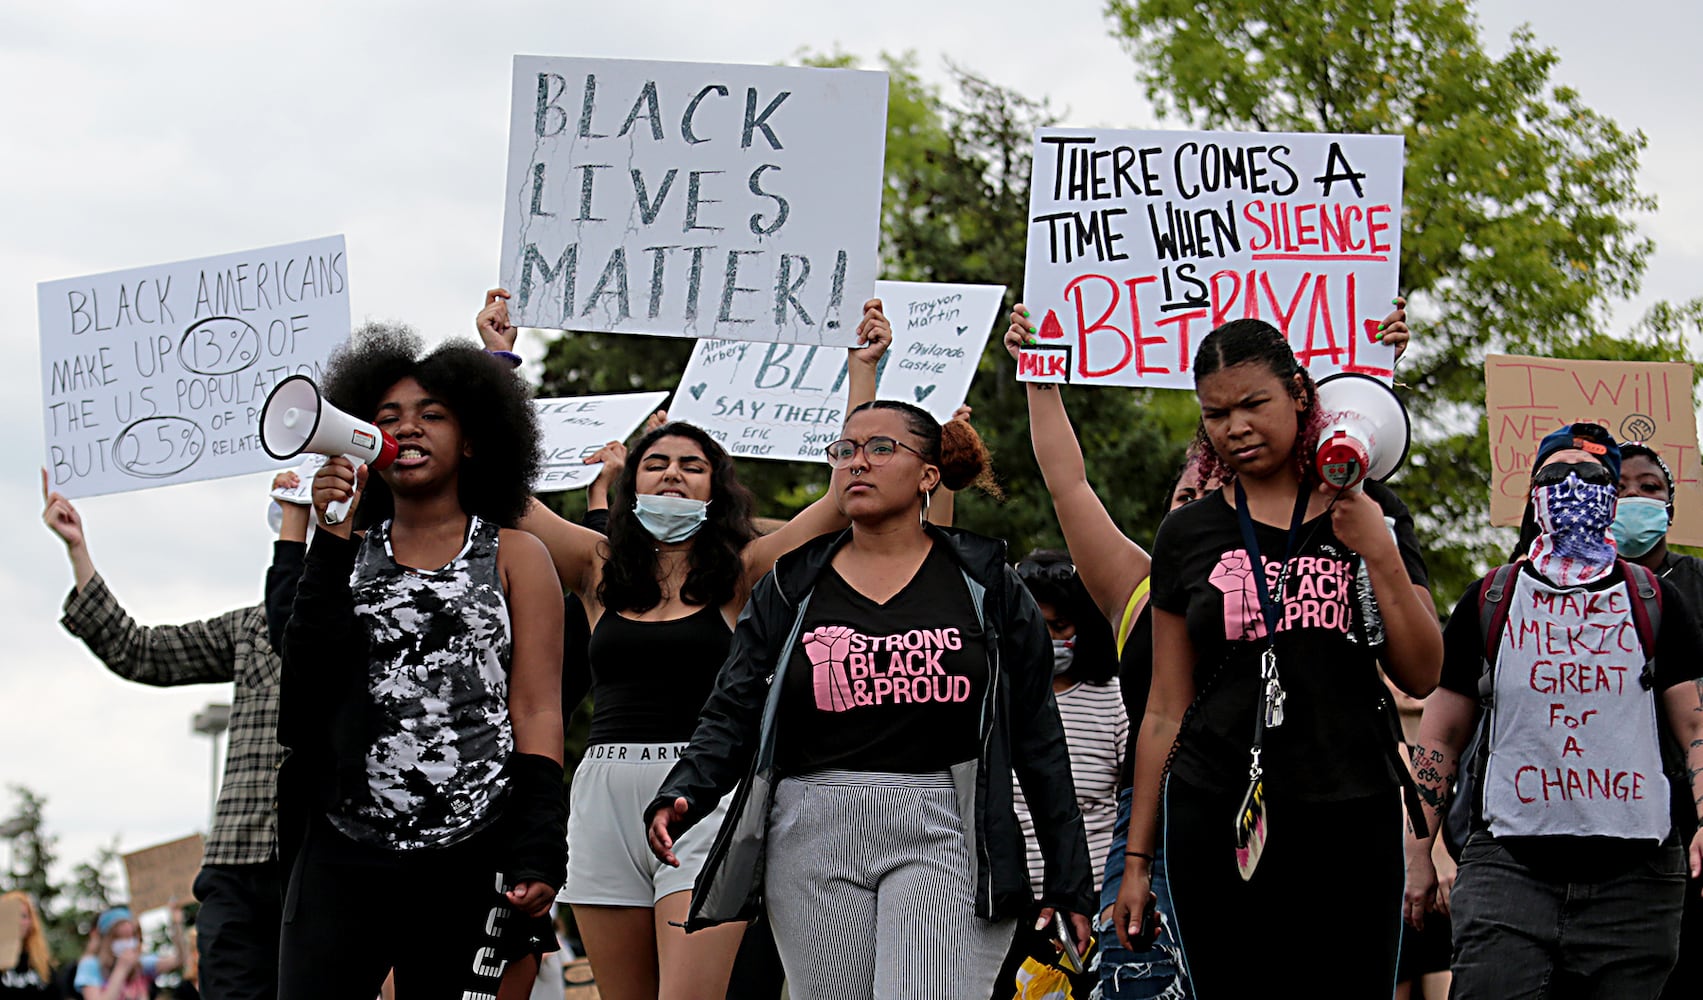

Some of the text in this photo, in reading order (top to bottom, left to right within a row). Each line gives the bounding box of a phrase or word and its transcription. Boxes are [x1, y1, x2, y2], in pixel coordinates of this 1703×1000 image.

[535, 71, 791, 151] BLACK
[1041, 136, 1366, 200] THERE COMES A
[529, 162, 791, 236] LIVES
[1033, 199, 1392, 264] TIME WHEN SILENCE
[68, 251, 344, 335] BLACK AMERICANS
[517, 242, 848, 329] MATTER!
[1161, 262, 1209, 302] IS
[907, 293, 962, 316] Trayvon
[907, 308, 960, 331] Martin
[1064, 269, 1393, 379] BETRAYAL
[51, 314, 309, 396] MAKE UP 13% OF
[702, 341, 752, 367] Arbery
[908, 341, 965, 359] Philando
[1019, 350, 1066, 377] MLK
[49, 400, 99, 437] THE
[176, 360, 325, 413] POPULAT
[1496, 363, 1565, 410] I
[211, 411, 235, 431] OF
[712, 396, 841, 425] SAY THEIR
[211, 434, 261, 457] RELATE
[731, 441, 775, 455] Garner
[742, 427, 772, 439] Eric
[803, 431, 840, 444] Sandr
[51, 437, 110, 486] BUT
[798, 445, 826, 456] Blan
[544, 470, 580, 481] ER
[1267, 574, 1349, 605] LACK
[1275, 600, 1353, 634] PROU
[1532, 590, 1628, 620] MAKE
[850, 627, 962, 653] STRONG
[849, 650, 946, 680] BLACK
[1529, 660, 1628, 696] GREAT
[853, 675, 971, 707] &PROUD
[1550, 703, 1597, 729] For
[588, 745, 686, 761] NDER ARM
[1562, 735, 1584, 758] A
[1515, 765, 1646, 805] CHANGE
